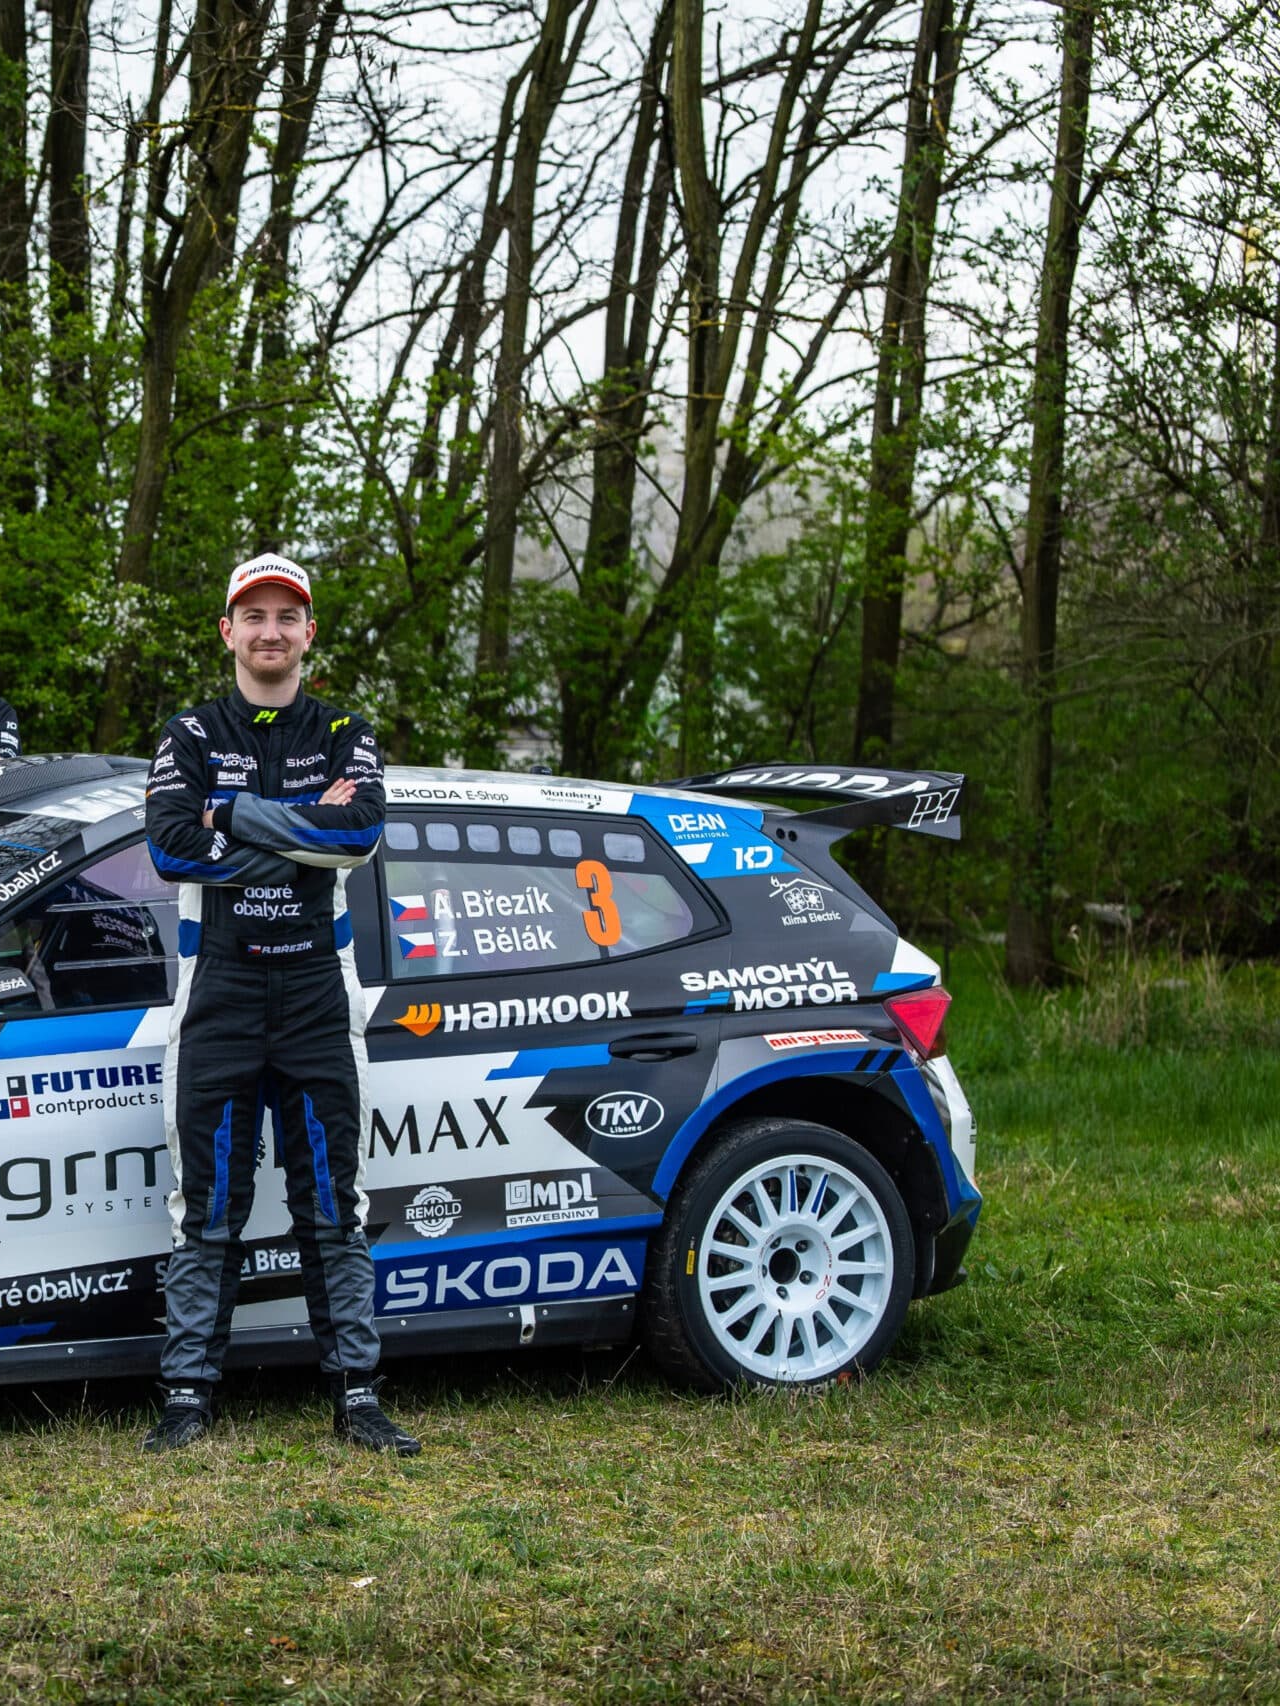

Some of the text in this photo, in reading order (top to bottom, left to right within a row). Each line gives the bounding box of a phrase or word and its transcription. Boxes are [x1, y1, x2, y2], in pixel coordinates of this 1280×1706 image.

[668, 813, 727, 832] DEAN
[462, 887, 554, 918] Březík
[575, 859, 622, 946] 3
[436, 925, 558, 957] Z. Bělák
[679, 957, 850, 992] SAMOHÝL
[734, 981, 858, 1012] MOTOR
[36, 1093, 163, 1115] contproduct s.
[596, 1099, 649, 1126] TKV
[368, 1096, 510, 1159] MAX
[65, 1195, 170, 1216] SYSTE
[405, 1202, 462, 1220] REMOLD
[509, 1209, 595, 1225] STAVEBNINY
[254, 1249, 302, 1272] Břez
[26, 1271, 129, 1305] obaly.cz
[383, 1247, 638, 1310] SKODA
